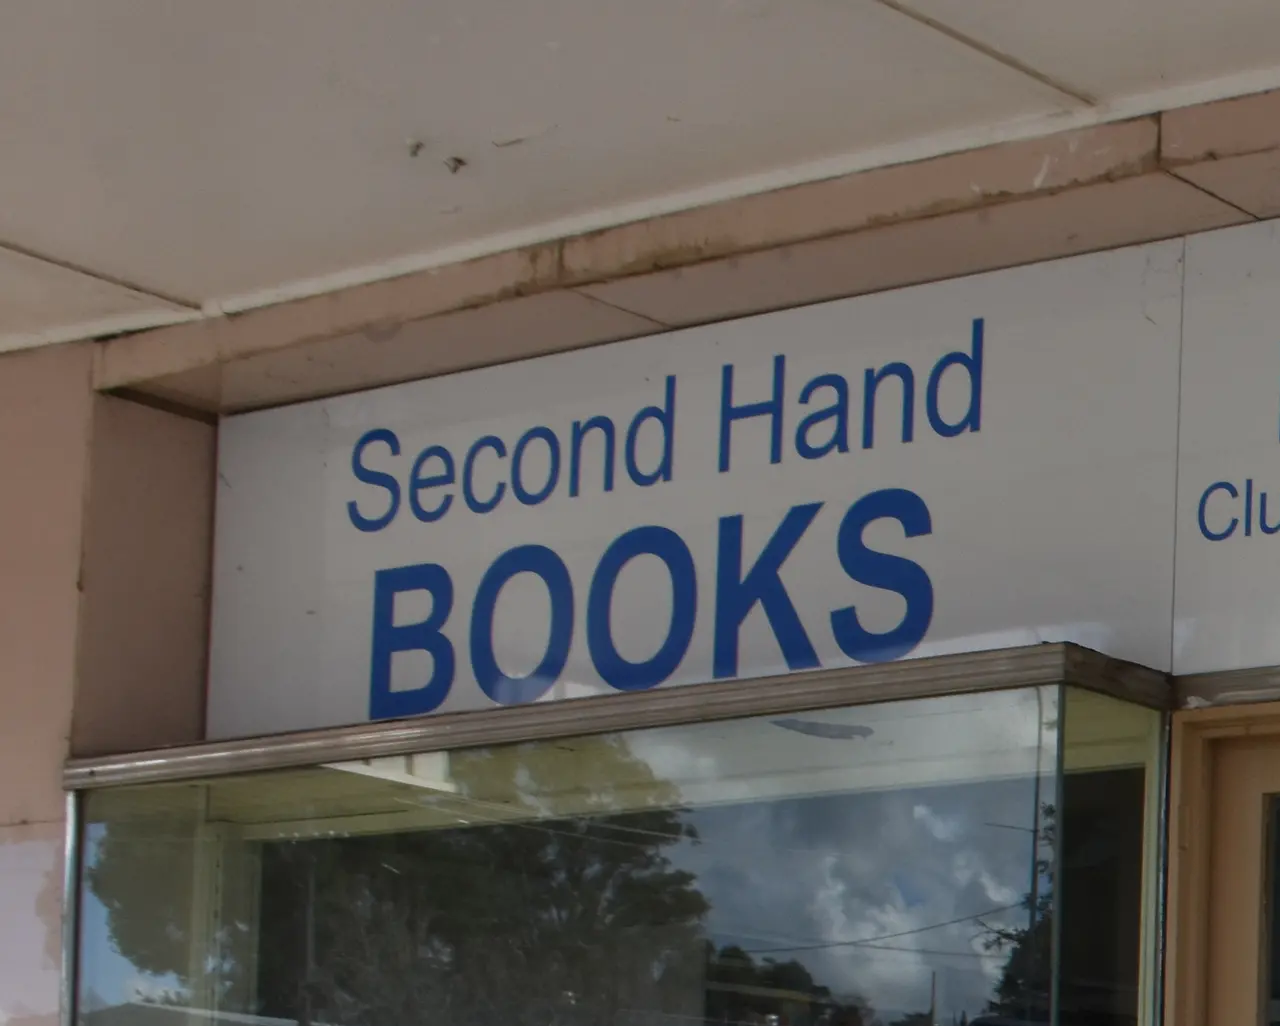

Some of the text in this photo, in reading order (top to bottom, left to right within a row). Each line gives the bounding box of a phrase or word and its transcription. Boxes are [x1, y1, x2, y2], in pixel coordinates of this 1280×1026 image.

[346, 317, 985, 532] Second Hand
[368, 487, 935, 721] BOOKS
